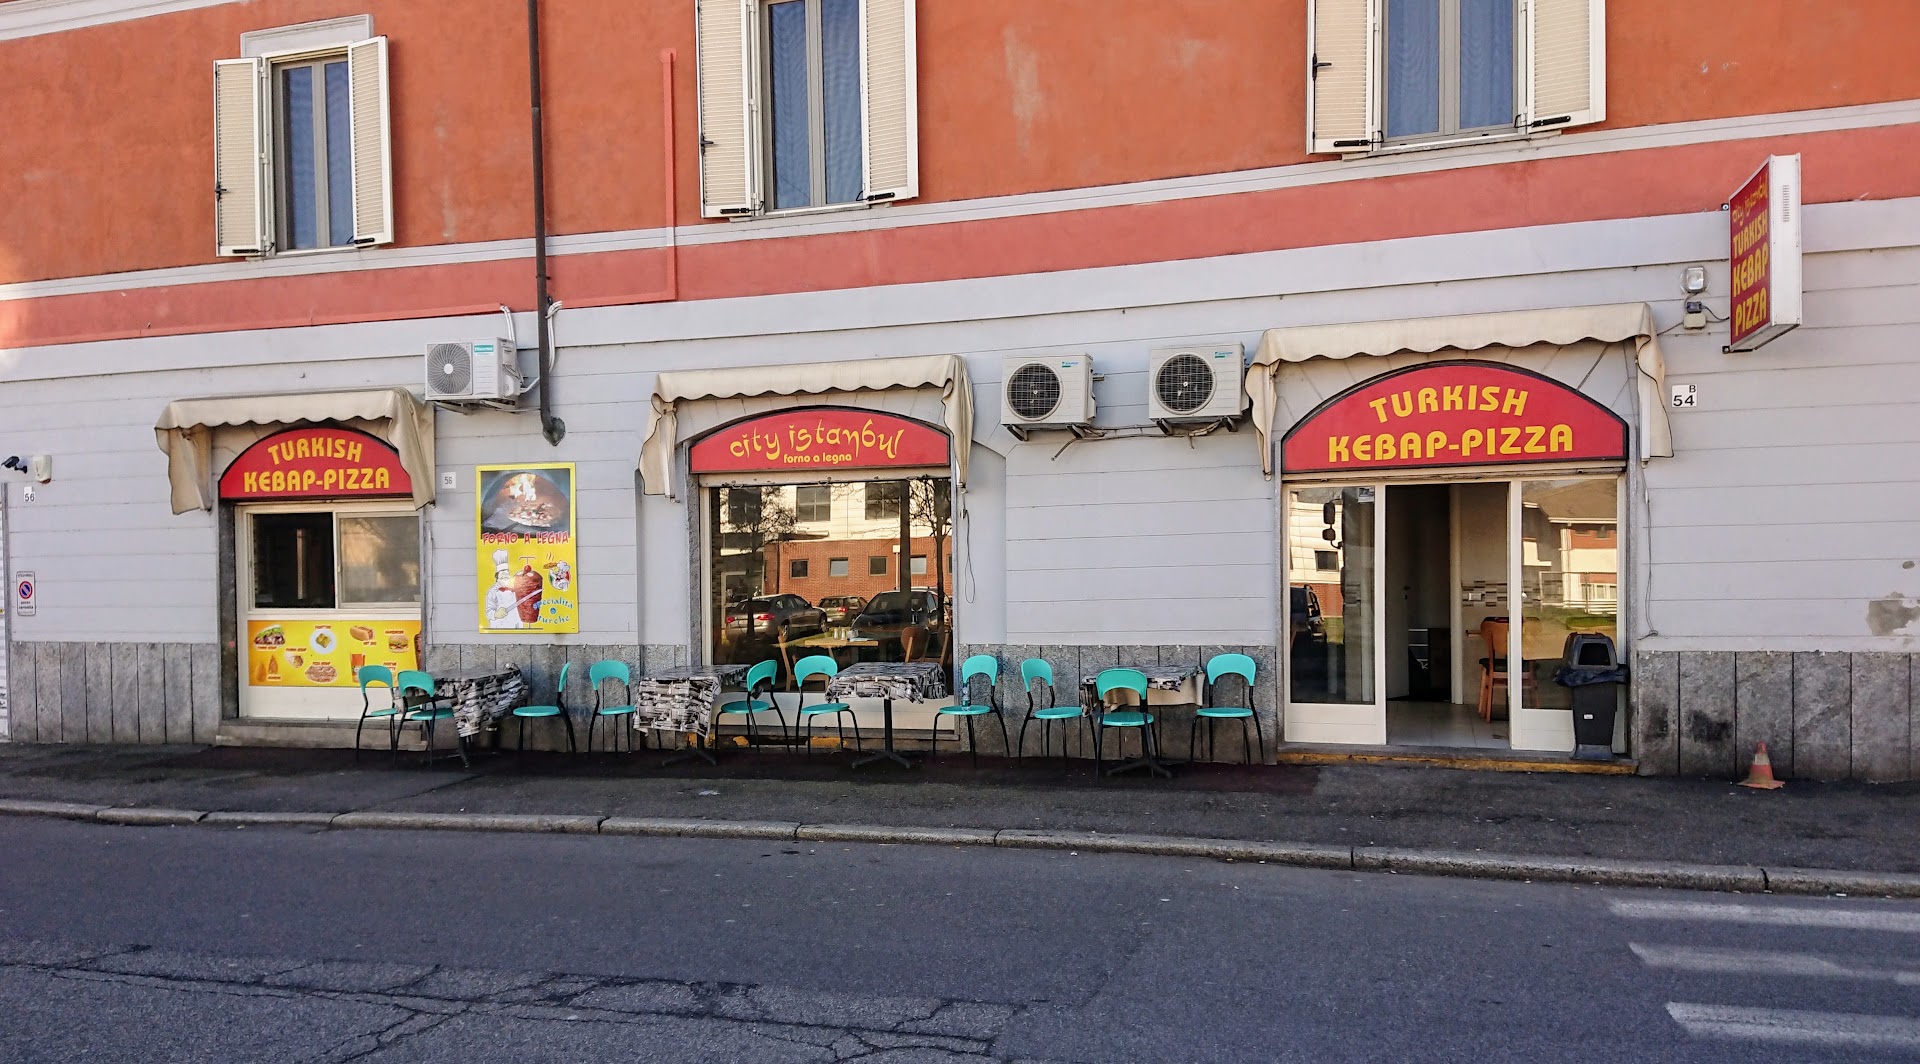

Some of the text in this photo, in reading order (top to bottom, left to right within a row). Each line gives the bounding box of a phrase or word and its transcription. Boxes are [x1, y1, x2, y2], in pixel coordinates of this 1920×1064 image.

[1733, 208, 1768, 259] TURKISH
[1733, 242, 1769, 298] KEBAP
[1734, 287, 1767, 337] PIZZA
[1673, 394, 1695, 407] 54
[1689, 384, 1697, 393] B
[1369, 385, 1529, 423] TURKISH
[267, 437, 363, 465] TURKISH
[729, 418, 905, 460] city istanbul
[1328, 424, 1573, 462] KEBAP-PIZZA
[783, 452, 852, 464] forno a legna
[243, 467, 390, 493] KEBAP-PIZZA
[444, 476, 453, 485] 56
[24, 493, 35, 502] 56
[482, 530, 569, 545] FORNO A LEGNA
